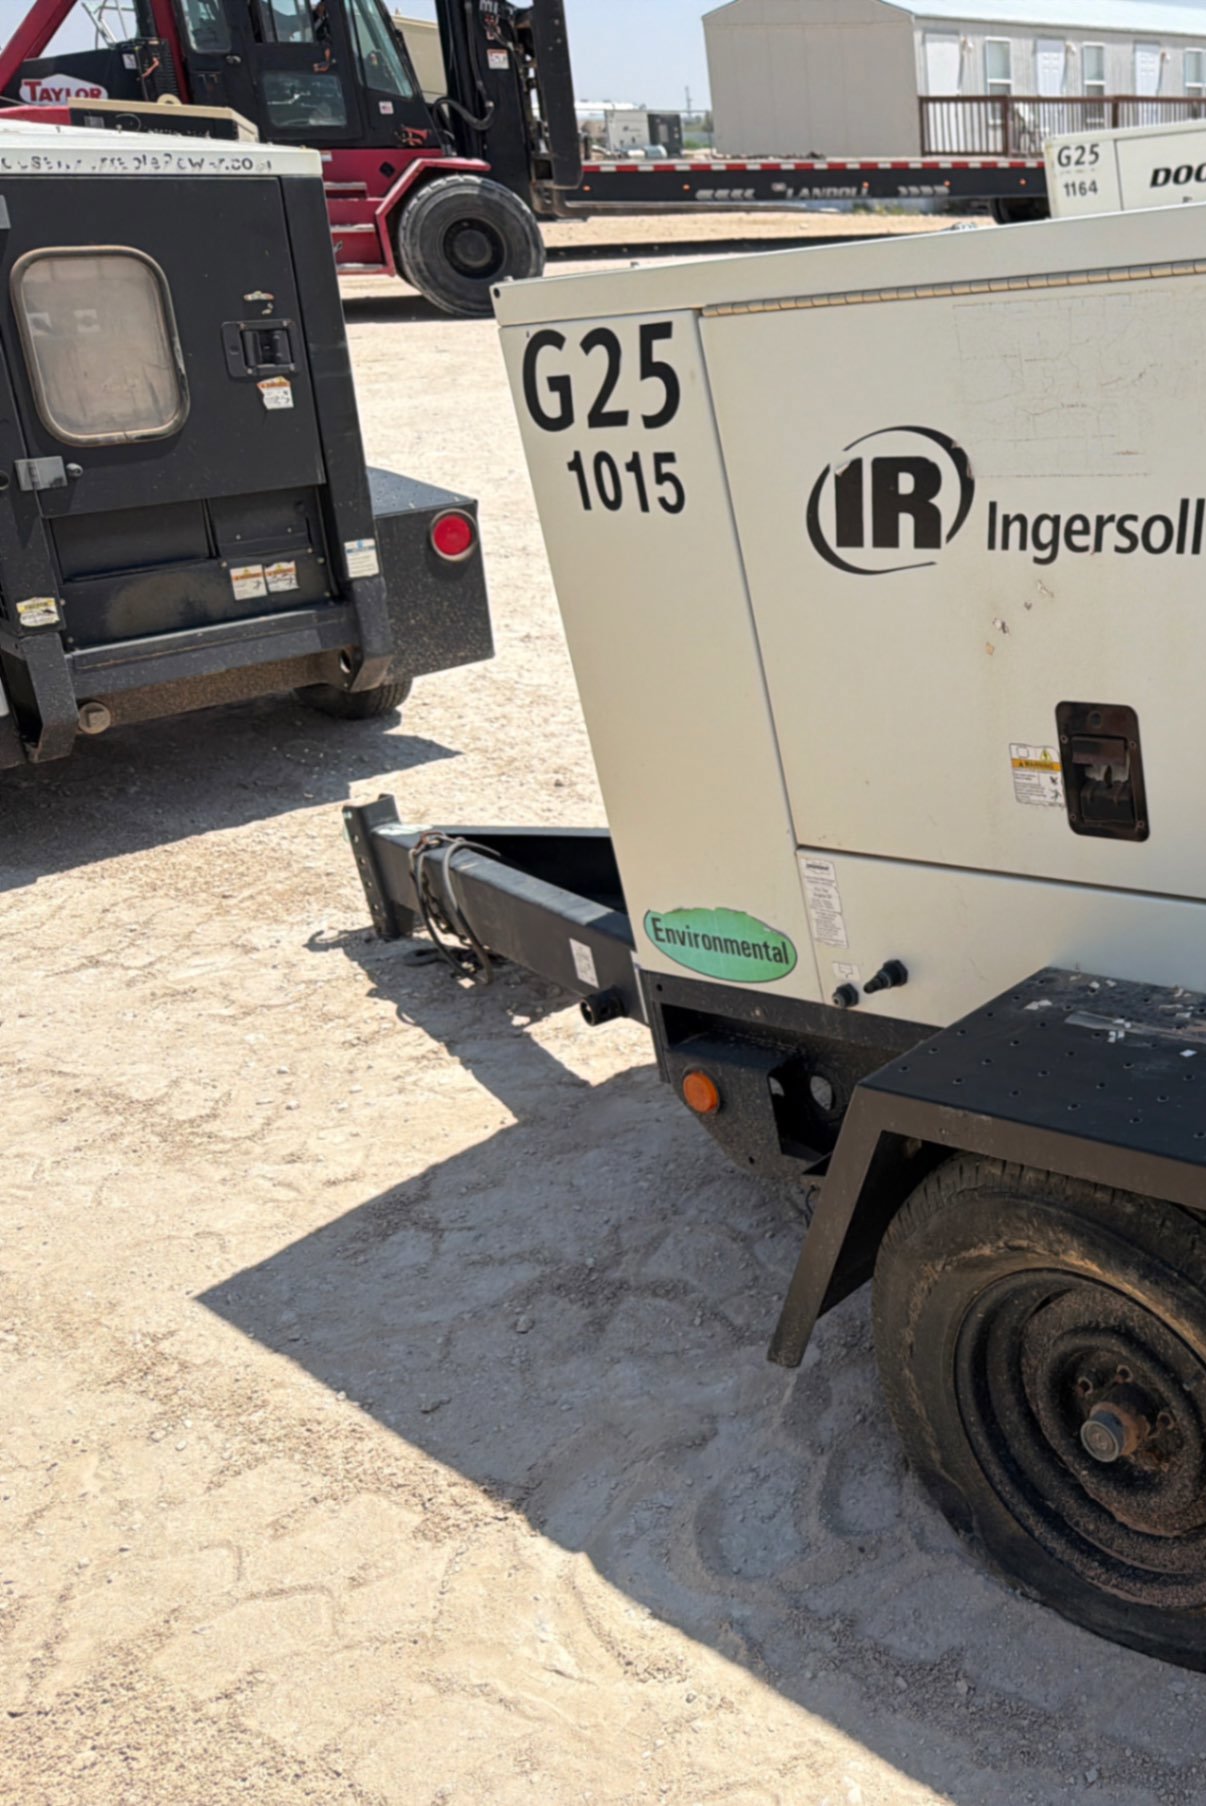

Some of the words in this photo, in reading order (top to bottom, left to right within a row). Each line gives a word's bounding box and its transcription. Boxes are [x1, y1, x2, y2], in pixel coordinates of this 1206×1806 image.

[23, 81, 103, 102] TAYLOR
[1057, 143, 1100, 168] G25
[1063, 180, 1098, 198] 1164
[522, 320, 681, 432] G25
[567, 450, 686, 514] 1015
[833, 455, 943, 550] IR
[986, 498, 1206, 565] Ingersoll
[651, 917, 790, 965] Environmental
